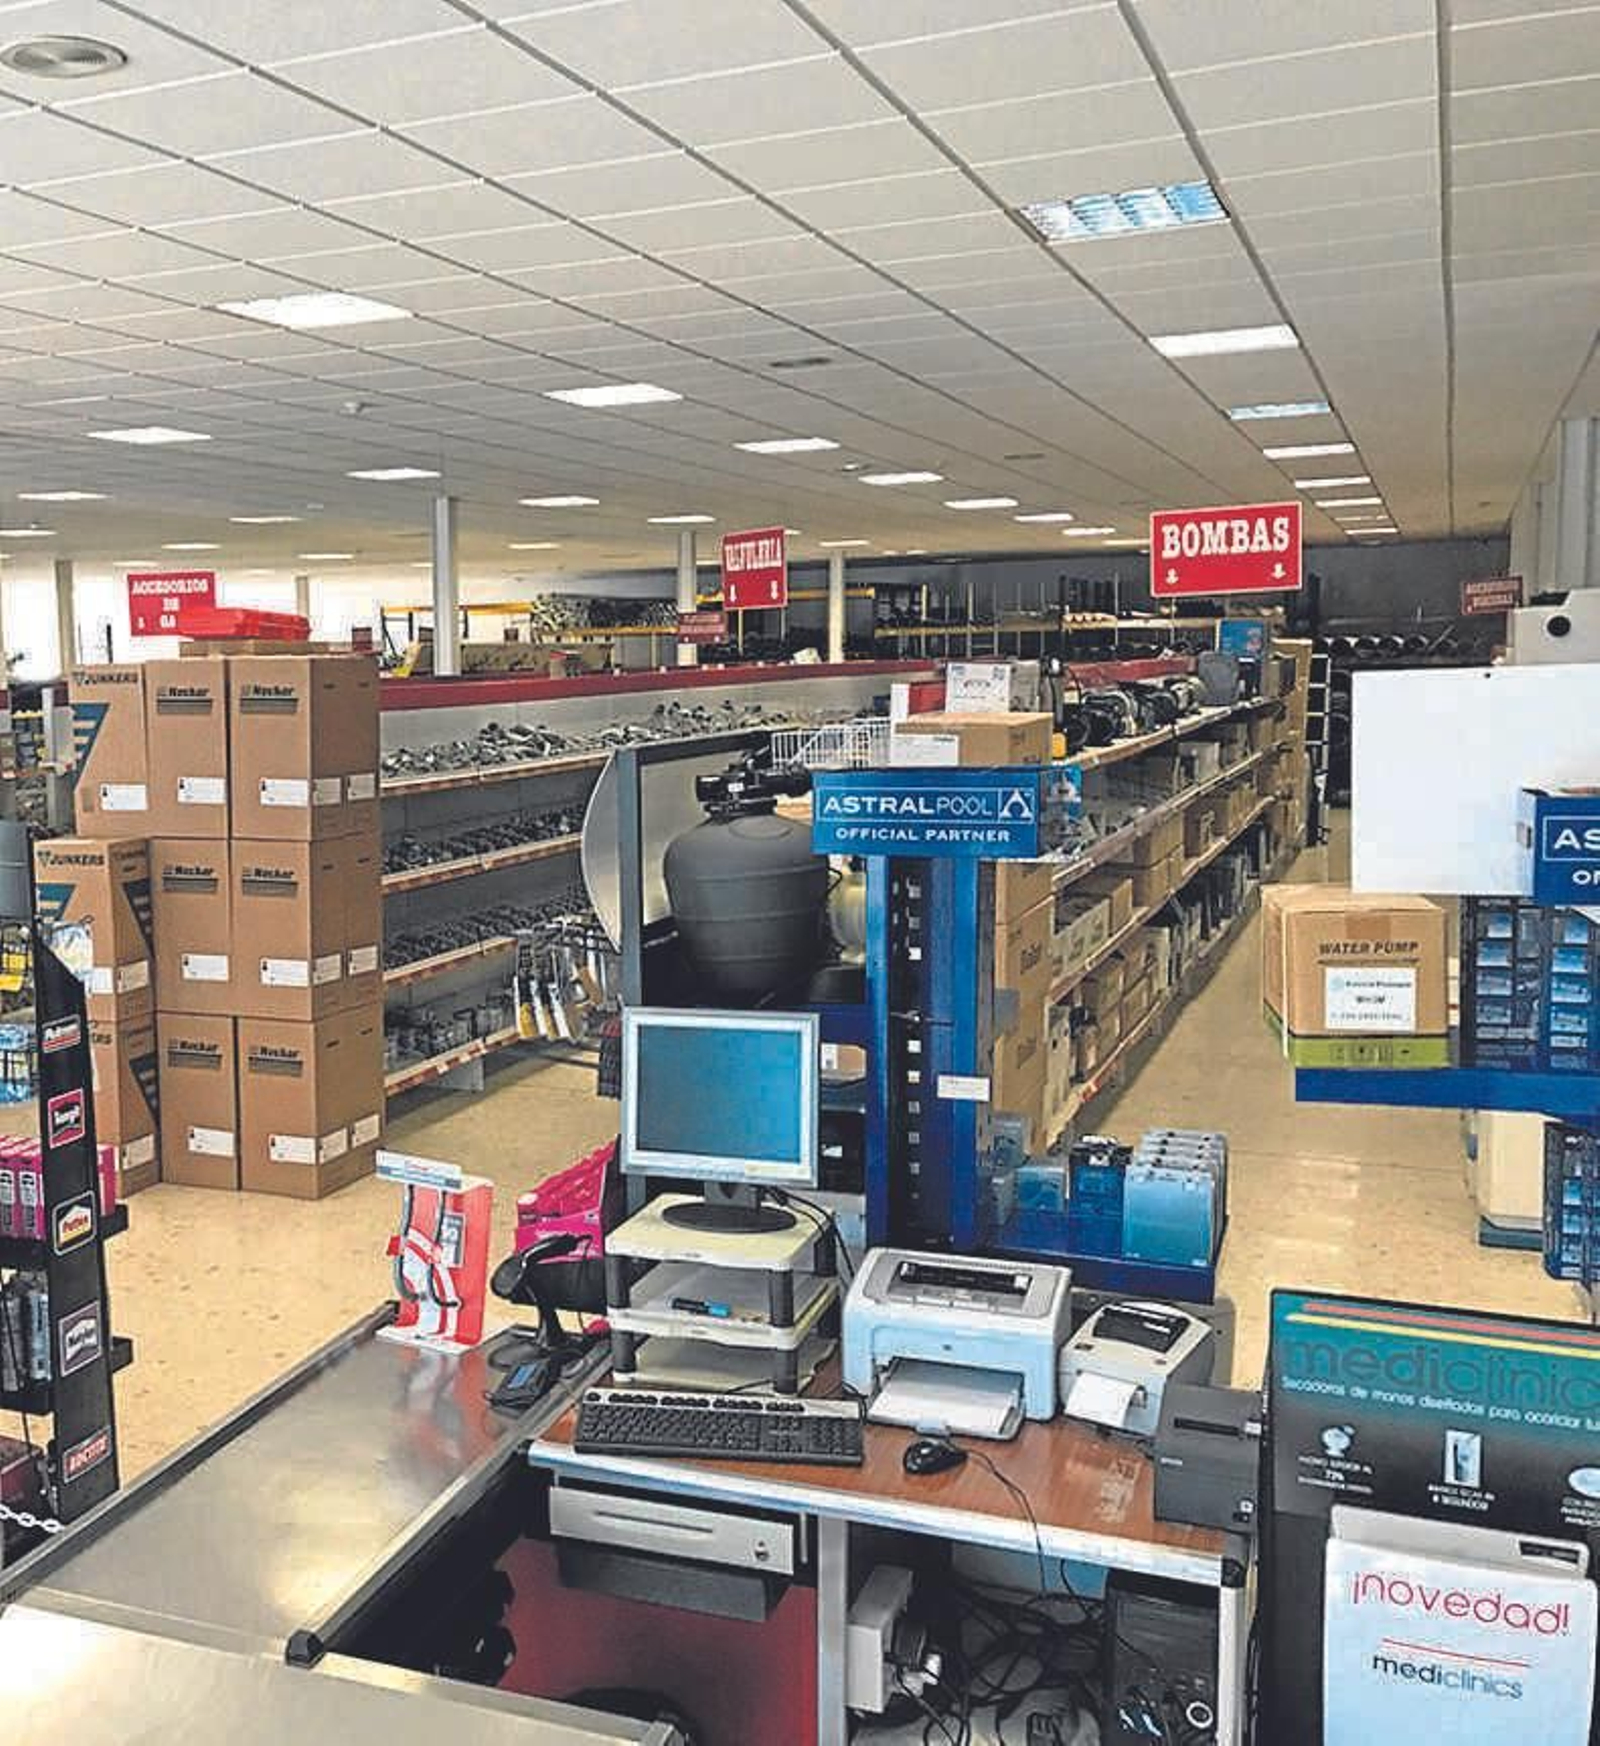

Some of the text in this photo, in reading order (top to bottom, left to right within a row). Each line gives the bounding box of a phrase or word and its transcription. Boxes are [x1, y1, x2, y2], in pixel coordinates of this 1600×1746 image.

[1161, 517, 1290, 560] BOMBAS
[132, 579, 209, 594] ACCESORIOS
[824, 795, 994, 817] ASTRALPOOL
[835, 827, 1011, 843] OFFICIAL PARTNER
[1554, 828, 1600, 850] AS
[1319, 941, 1419, 955] WATER PUMP
[1350, 1386, 1368, 1398] de
[1489, 1406, 1521, 1421] para
[70, 1434, 108, 1472] LOCTITE
[1354, 1572, 1571, 1637] ¡novedad!
[1373, 1654, 1524, 1700] mediclinics
